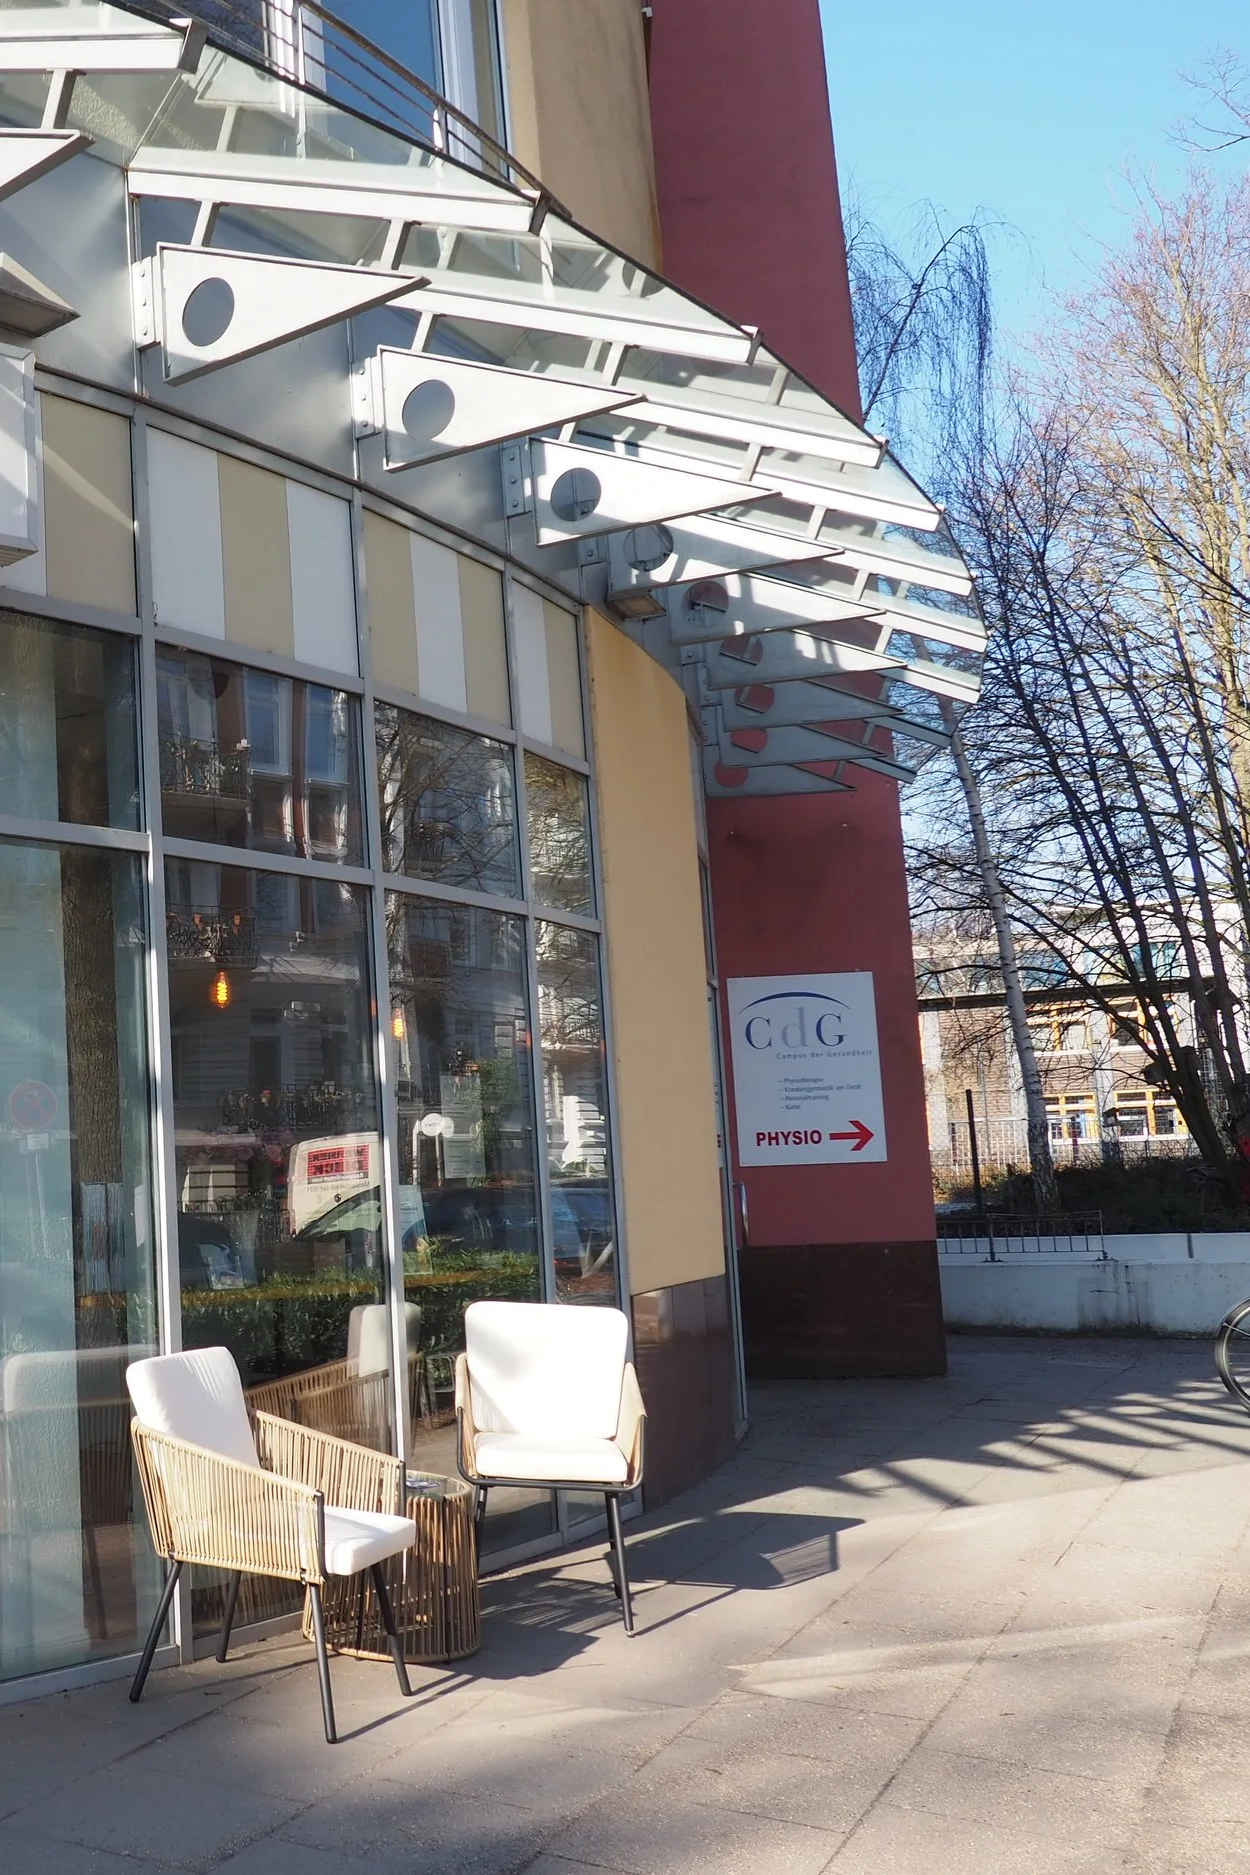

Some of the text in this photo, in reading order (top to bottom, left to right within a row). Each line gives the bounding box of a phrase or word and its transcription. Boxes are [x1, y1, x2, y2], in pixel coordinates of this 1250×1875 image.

[745, 1006, 847, 1050] CdG
[776, 1052, 807, 1060] Campus
[827, 1049, 873, 1058] Gesundheit
[756, 1129, 823, 1147] PHYSIO
